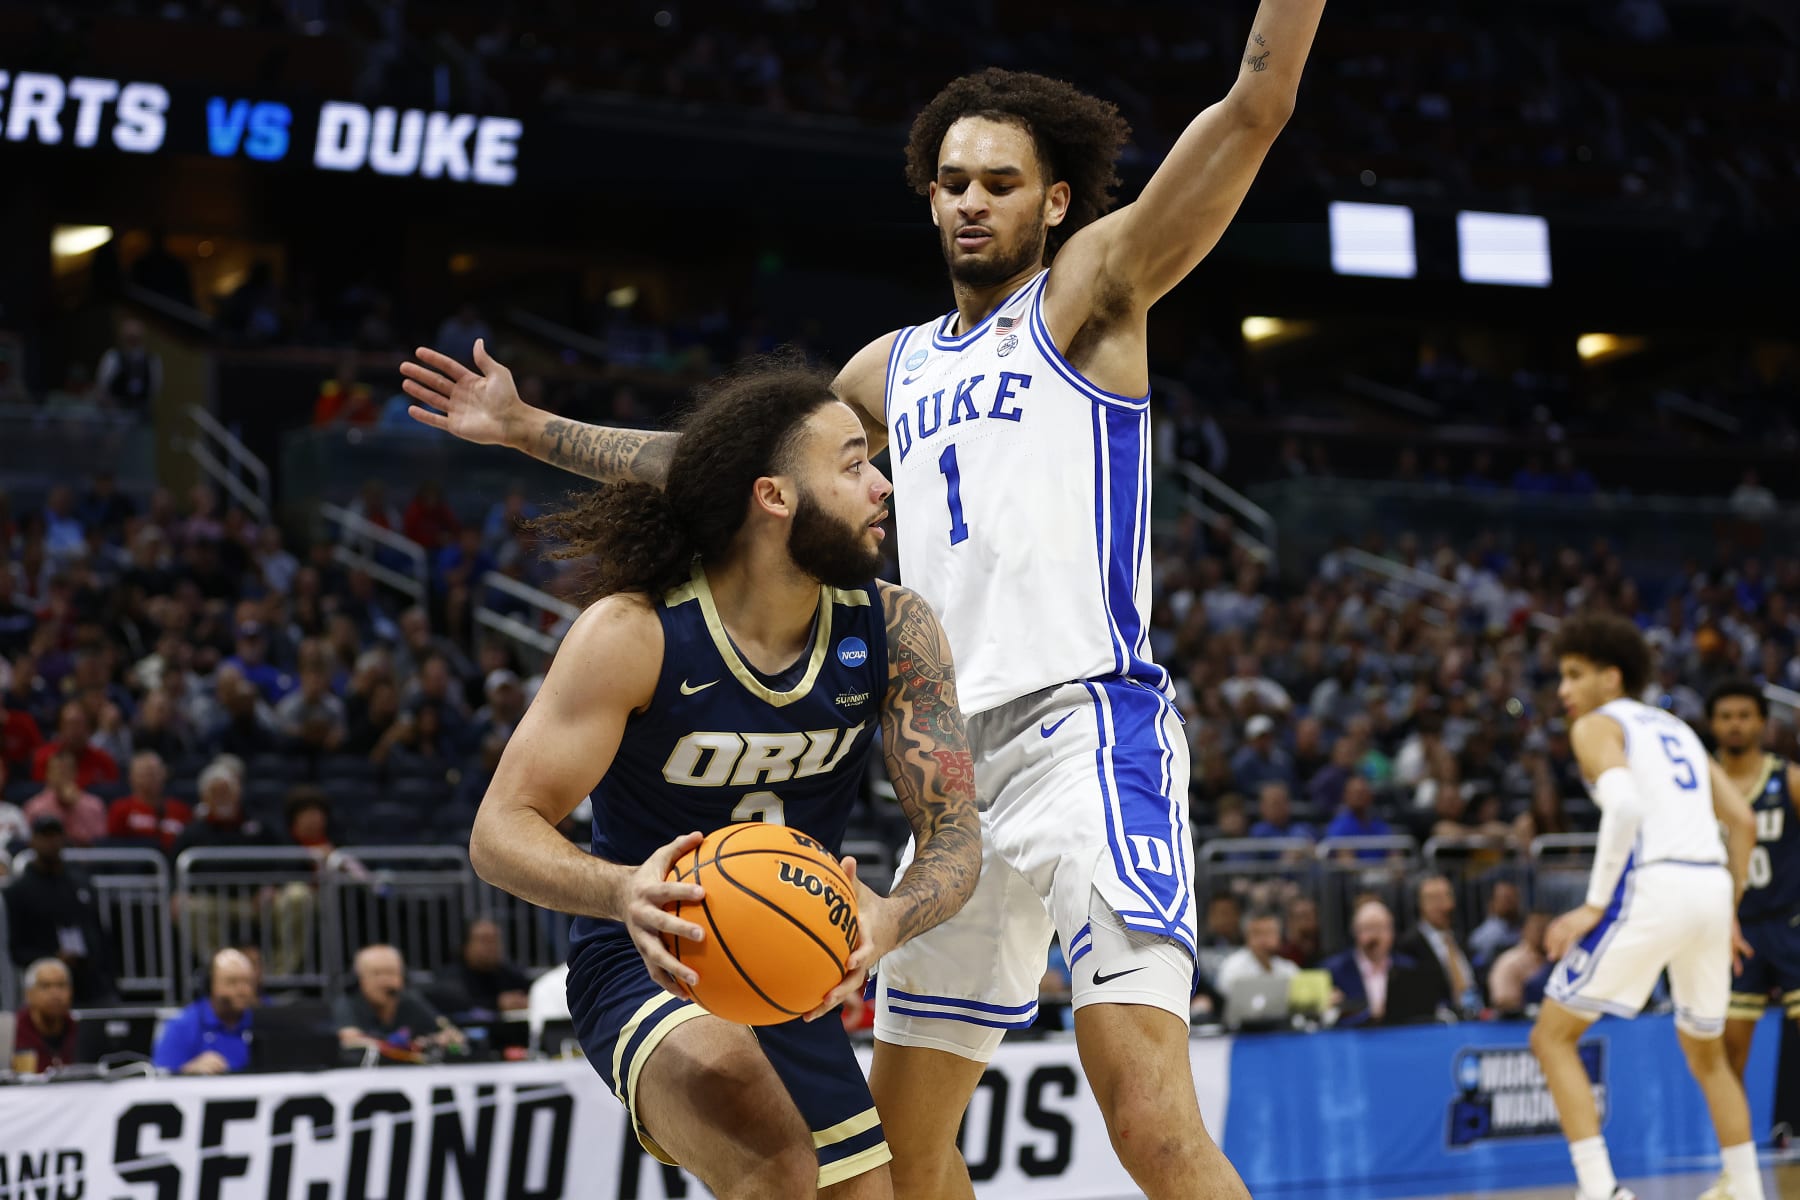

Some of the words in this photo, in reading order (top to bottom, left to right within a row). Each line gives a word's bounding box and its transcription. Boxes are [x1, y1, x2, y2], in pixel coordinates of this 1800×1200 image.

[0, 70, 170, 153] RTS
[206, 96, 292, 161] VS
[314, 101, 523, 185] DUKE
[895, 371, 1032, 465] DUKE
[938, 443, 969, 546] 1
[841, 650, 867, 660] NCAA
[661, 720, 866, 787] ORU
[1658, 733, 1699, 790] 5
[113, 1083, 575, 1200] SECOND
